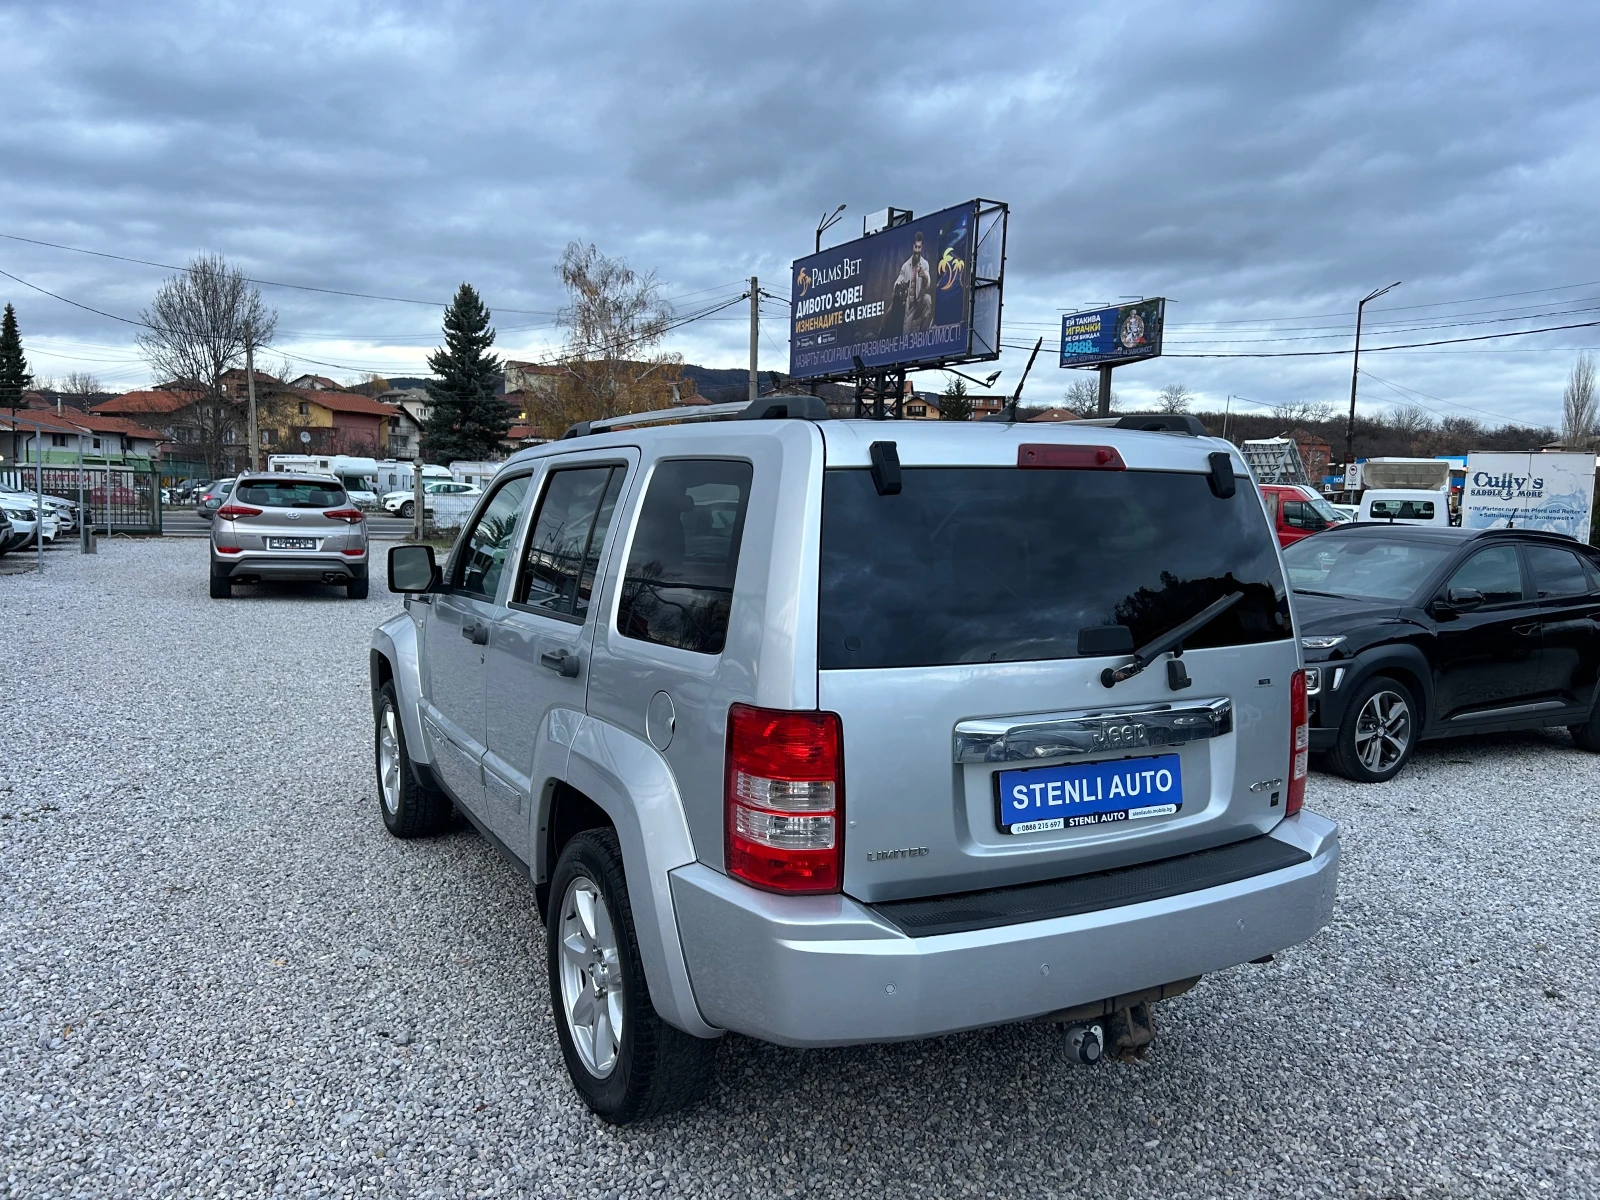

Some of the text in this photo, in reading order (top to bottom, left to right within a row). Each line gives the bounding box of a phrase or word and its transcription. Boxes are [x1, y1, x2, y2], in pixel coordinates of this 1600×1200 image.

[812, 258, 862, 288] PALMS BET
[796, 285, 863, 319] ДИВОТО ЗОВЕ!
[796, 300, 884, 333] ИЗНЕНАДИТЕ СА ЕХЕЕЕ!
[1076, 314, 1101, 325] ТАКИВА
[1066, 322, 1101, 336] ИГРАЧКИ
[861, 337, 898, 356] РАЗВИВАНЕ
[898, 336, 909, 350] НА
[909, 326, 961, 349] ЗАВИСИМОСТ!
[1517, 490, 1543, 498] MORE
[1092, 722, 1147, 746] Jeep
[1012, 769, 1172, 810] STENLI AUTO
[1038, 822, 1049, 830] 215
[1050, 821, 1061, 829] 697
[1069, 812, 1125, 827] STENLI AUTO
[867, 846, 930, 861] LIMITED
